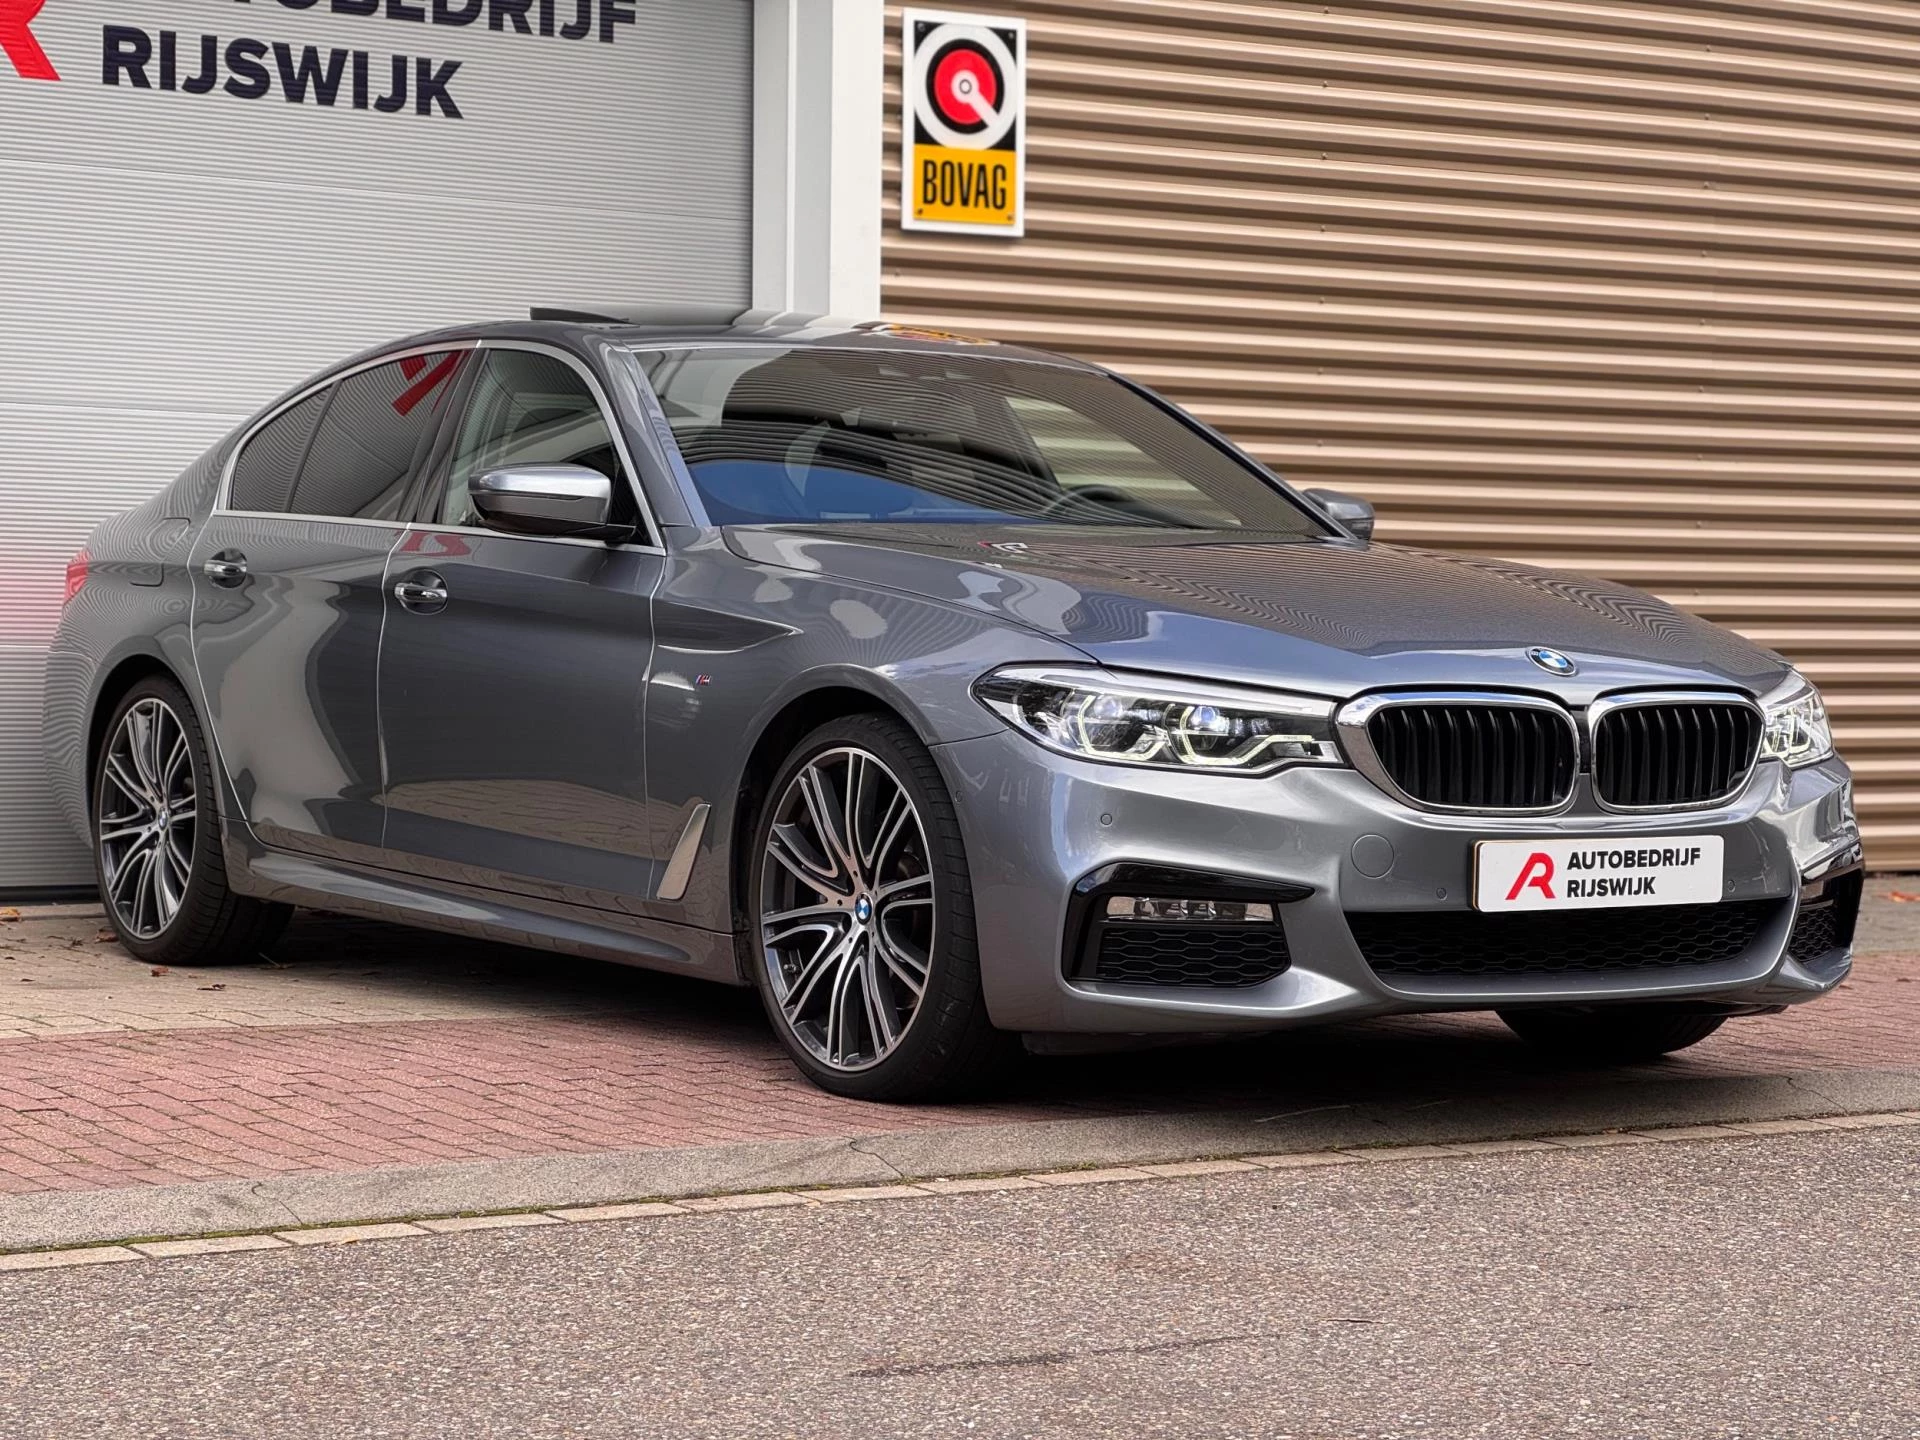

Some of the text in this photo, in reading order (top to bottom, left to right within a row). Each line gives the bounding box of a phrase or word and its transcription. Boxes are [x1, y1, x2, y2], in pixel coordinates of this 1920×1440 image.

[102, 24, 463, 119] RIJSWIJK
[922, 159, 1006, 210] BOVAG
[1567, 847, 1701, 870] AUTOBEDRIJF
[1567, 876, 1656, 898] RIJSWIJK
